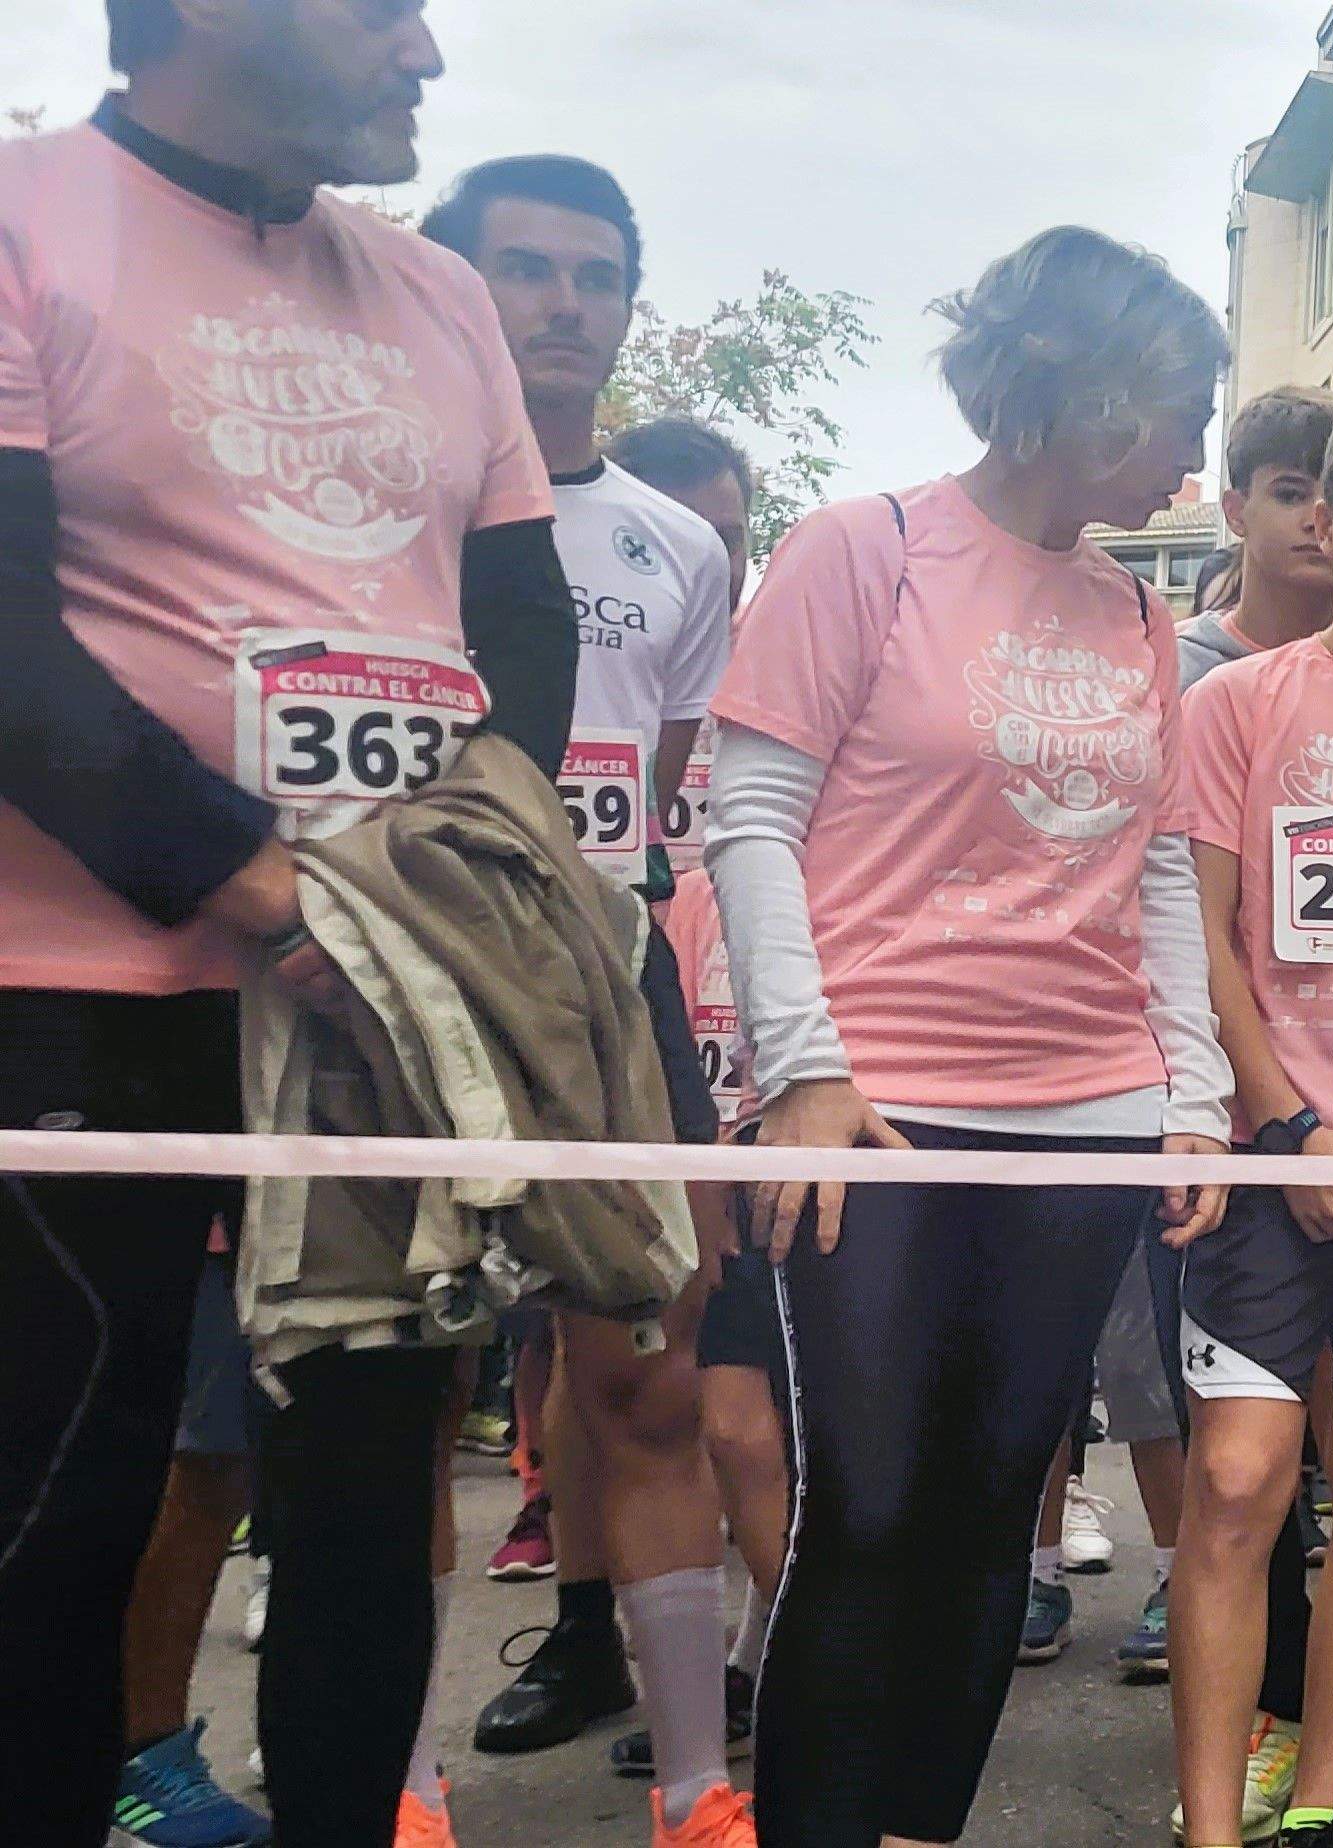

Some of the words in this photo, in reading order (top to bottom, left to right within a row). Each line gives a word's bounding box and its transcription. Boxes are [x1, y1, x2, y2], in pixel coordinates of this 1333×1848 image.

[276, 670, 383, 697] CONTRA
[388, 680, 413, 699] EL
[419, 682, 481, 710] CÁNCER
